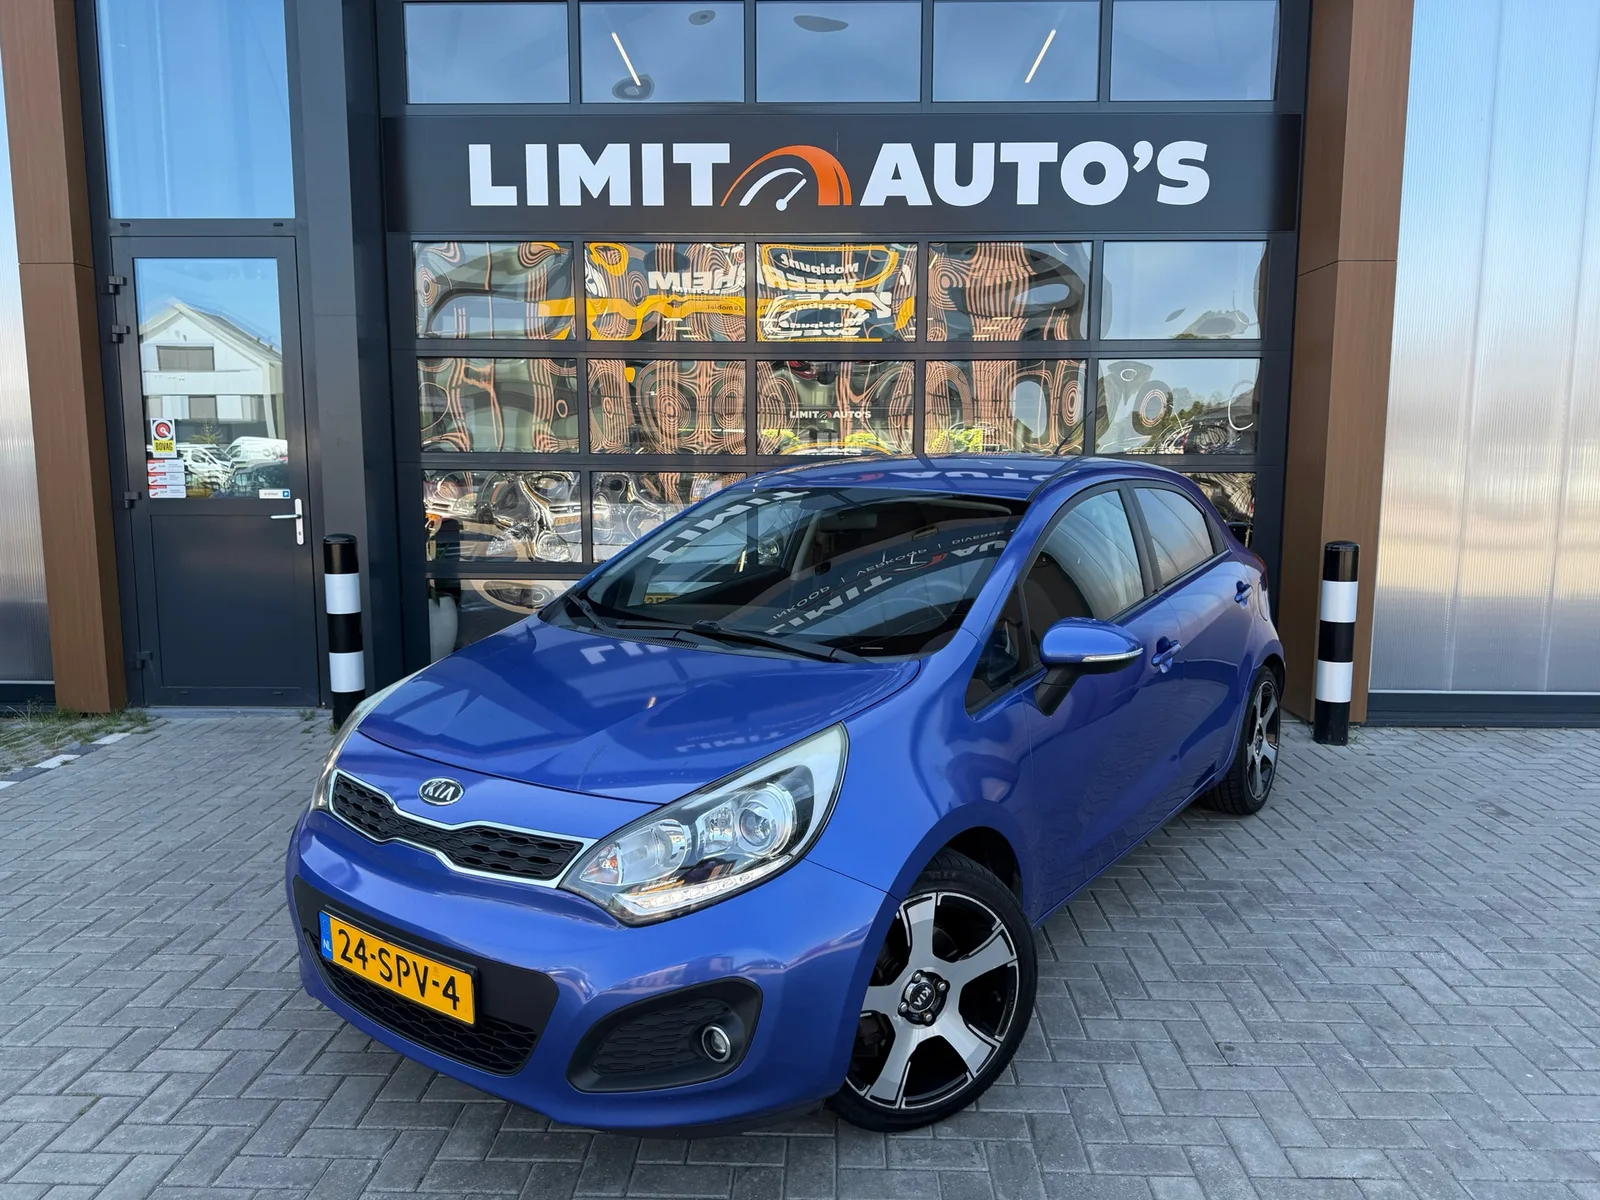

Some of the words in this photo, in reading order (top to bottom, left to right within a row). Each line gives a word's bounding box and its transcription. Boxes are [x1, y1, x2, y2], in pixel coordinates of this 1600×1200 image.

[468, 143, 731, 206] LIMIT
[860, 140, 1211, 207] AUTO'S
[789, 410, 819, 419] LIMIT
[155, 442, 174, 451] BOVAG
[424, 783, 455, 801] KIA
[322, 938, 332, 952] NL
[338, 928, 461, 1011] 24-SPV-4
[913, 986, 932, 1006] KIA
